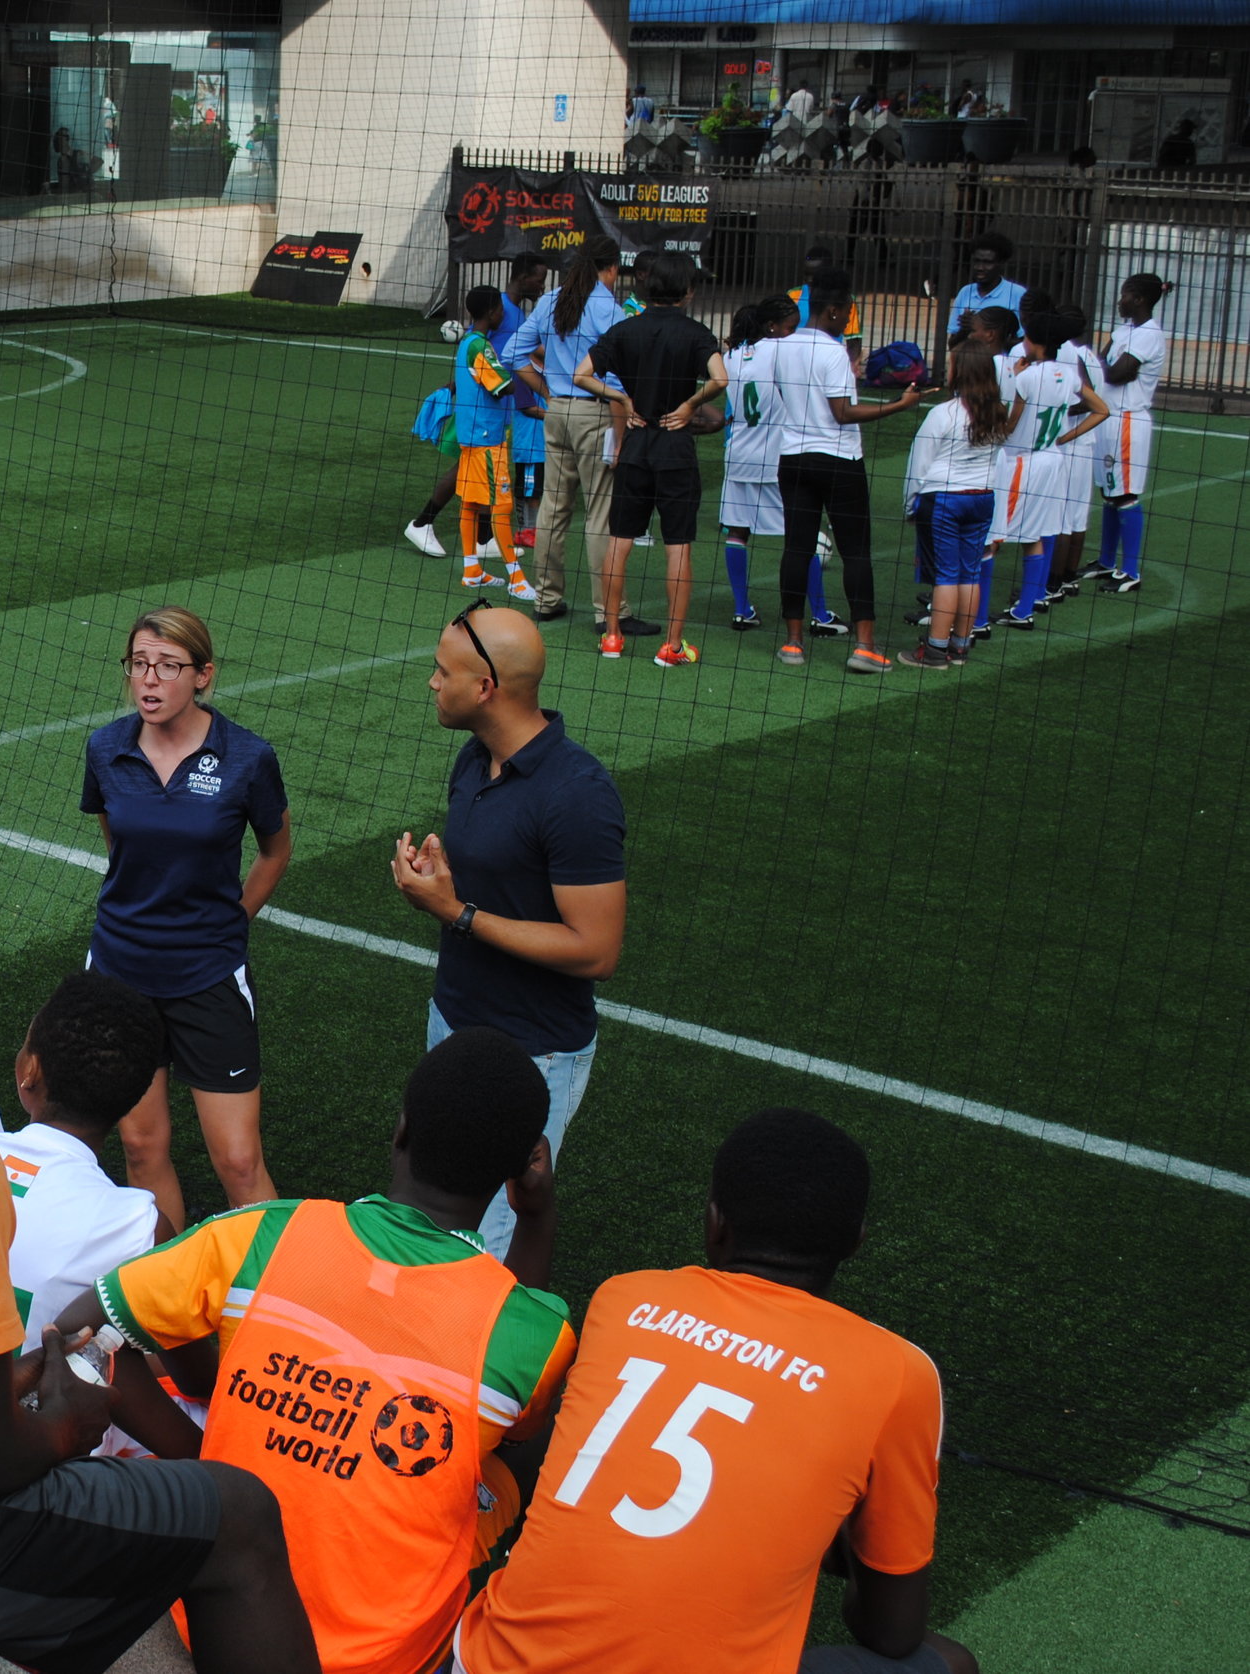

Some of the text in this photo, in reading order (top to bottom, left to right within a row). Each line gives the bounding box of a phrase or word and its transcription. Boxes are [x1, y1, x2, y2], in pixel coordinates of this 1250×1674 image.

[755, 61, 772, 74] OP
[505, 190, 575, 211] SOCCER
[600, 184, 710, 204] ADULT 5V5 LEAGUES
[618, 206, 708, 223] KIDS PLAY FOR FREE
[743, 381, 761, 428] 4
[1106, 472, 1115, 490] 9
[189, 773, 221, 785] SOCCER
[627, 1303, 826, 1393] CLARKSTON FC
[263, 1352, 372, 1408] street
[227, 1368, 358, 1441] football
[265, 1427, 363, 1481] world
[554, 1356, 755, 1538] 15
